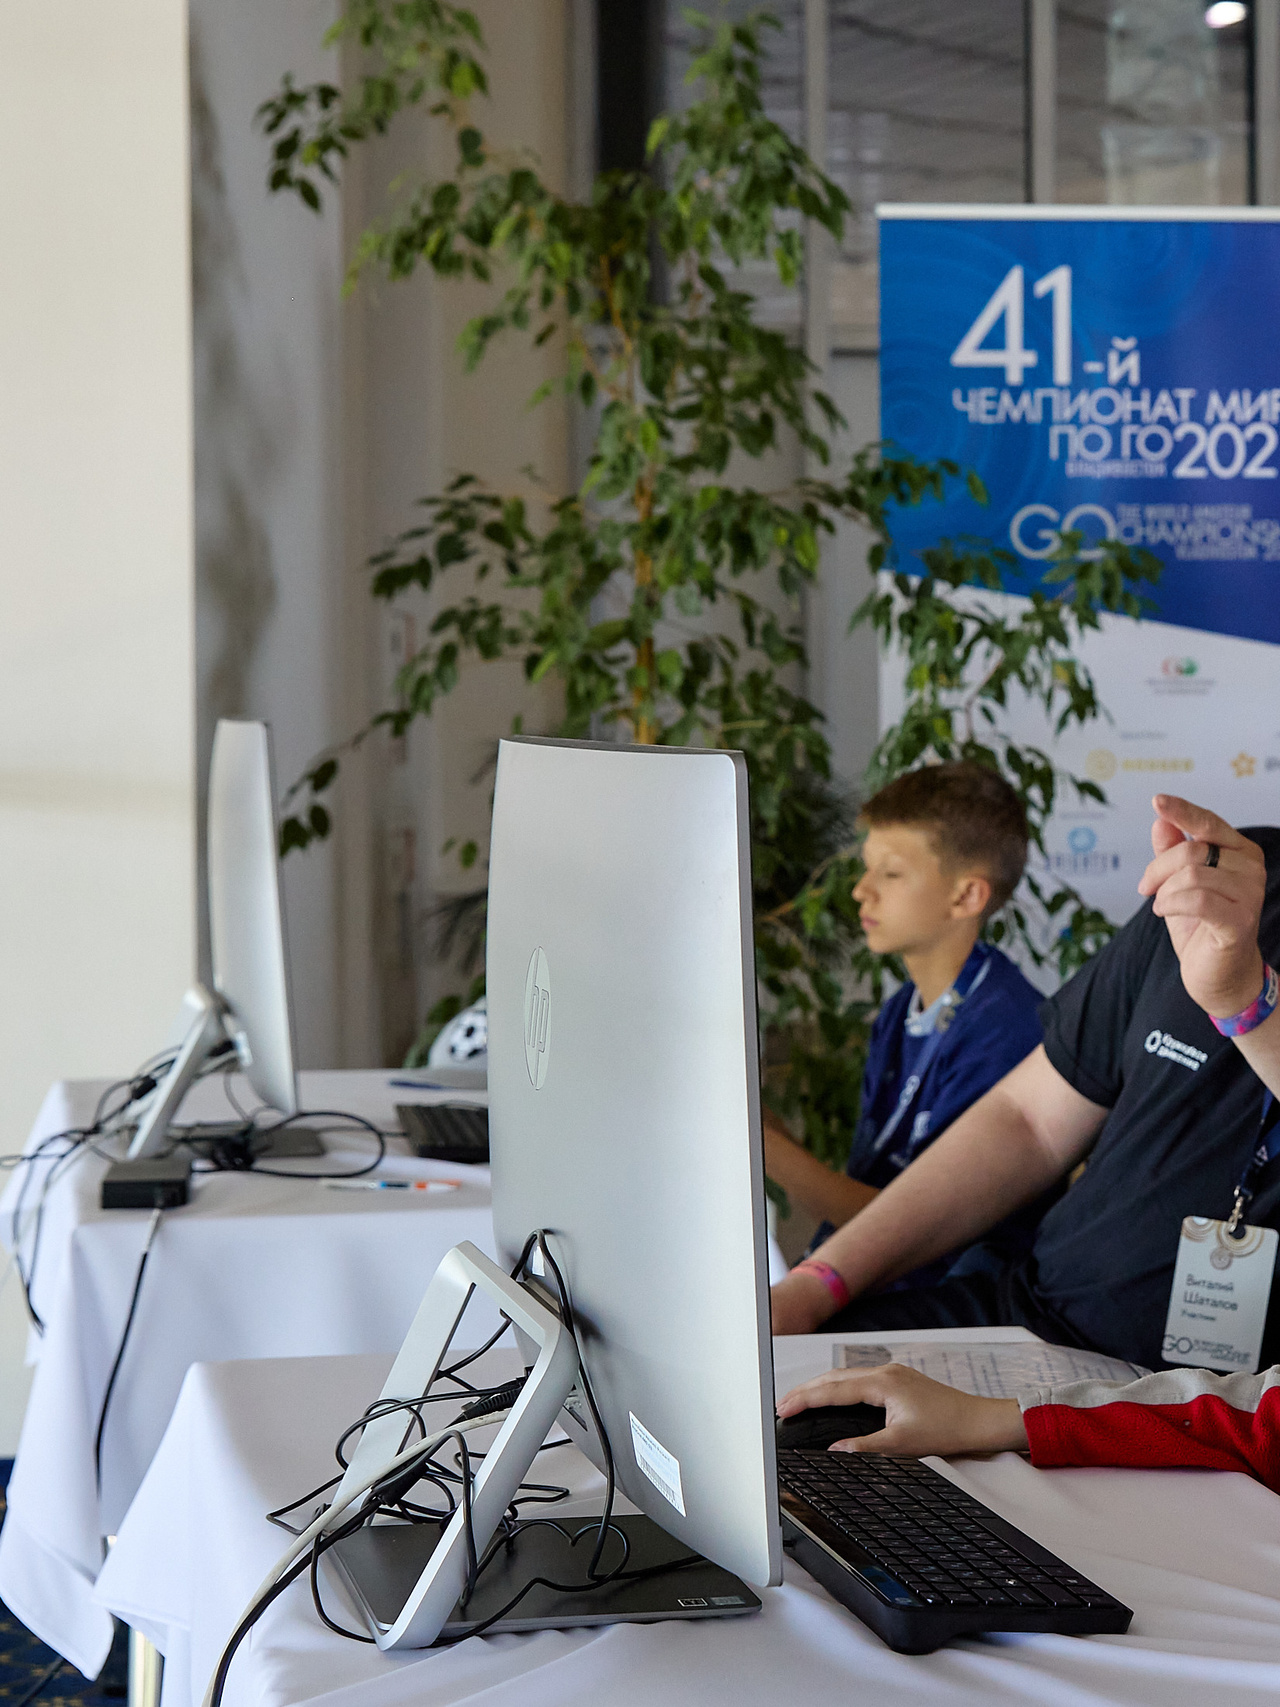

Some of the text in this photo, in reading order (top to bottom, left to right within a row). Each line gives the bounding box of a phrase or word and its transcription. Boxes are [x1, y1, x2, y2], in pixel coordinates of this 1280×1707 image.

[950, 265, 1140, 386] 41-й
[952, 388, 1196, 425] ЧЕМПИОНАТ
[1049, 425, 1112, 461] ПО
[1121, 425, 1173, 461] ГО
[1009, 503, 1117, 560] GO
